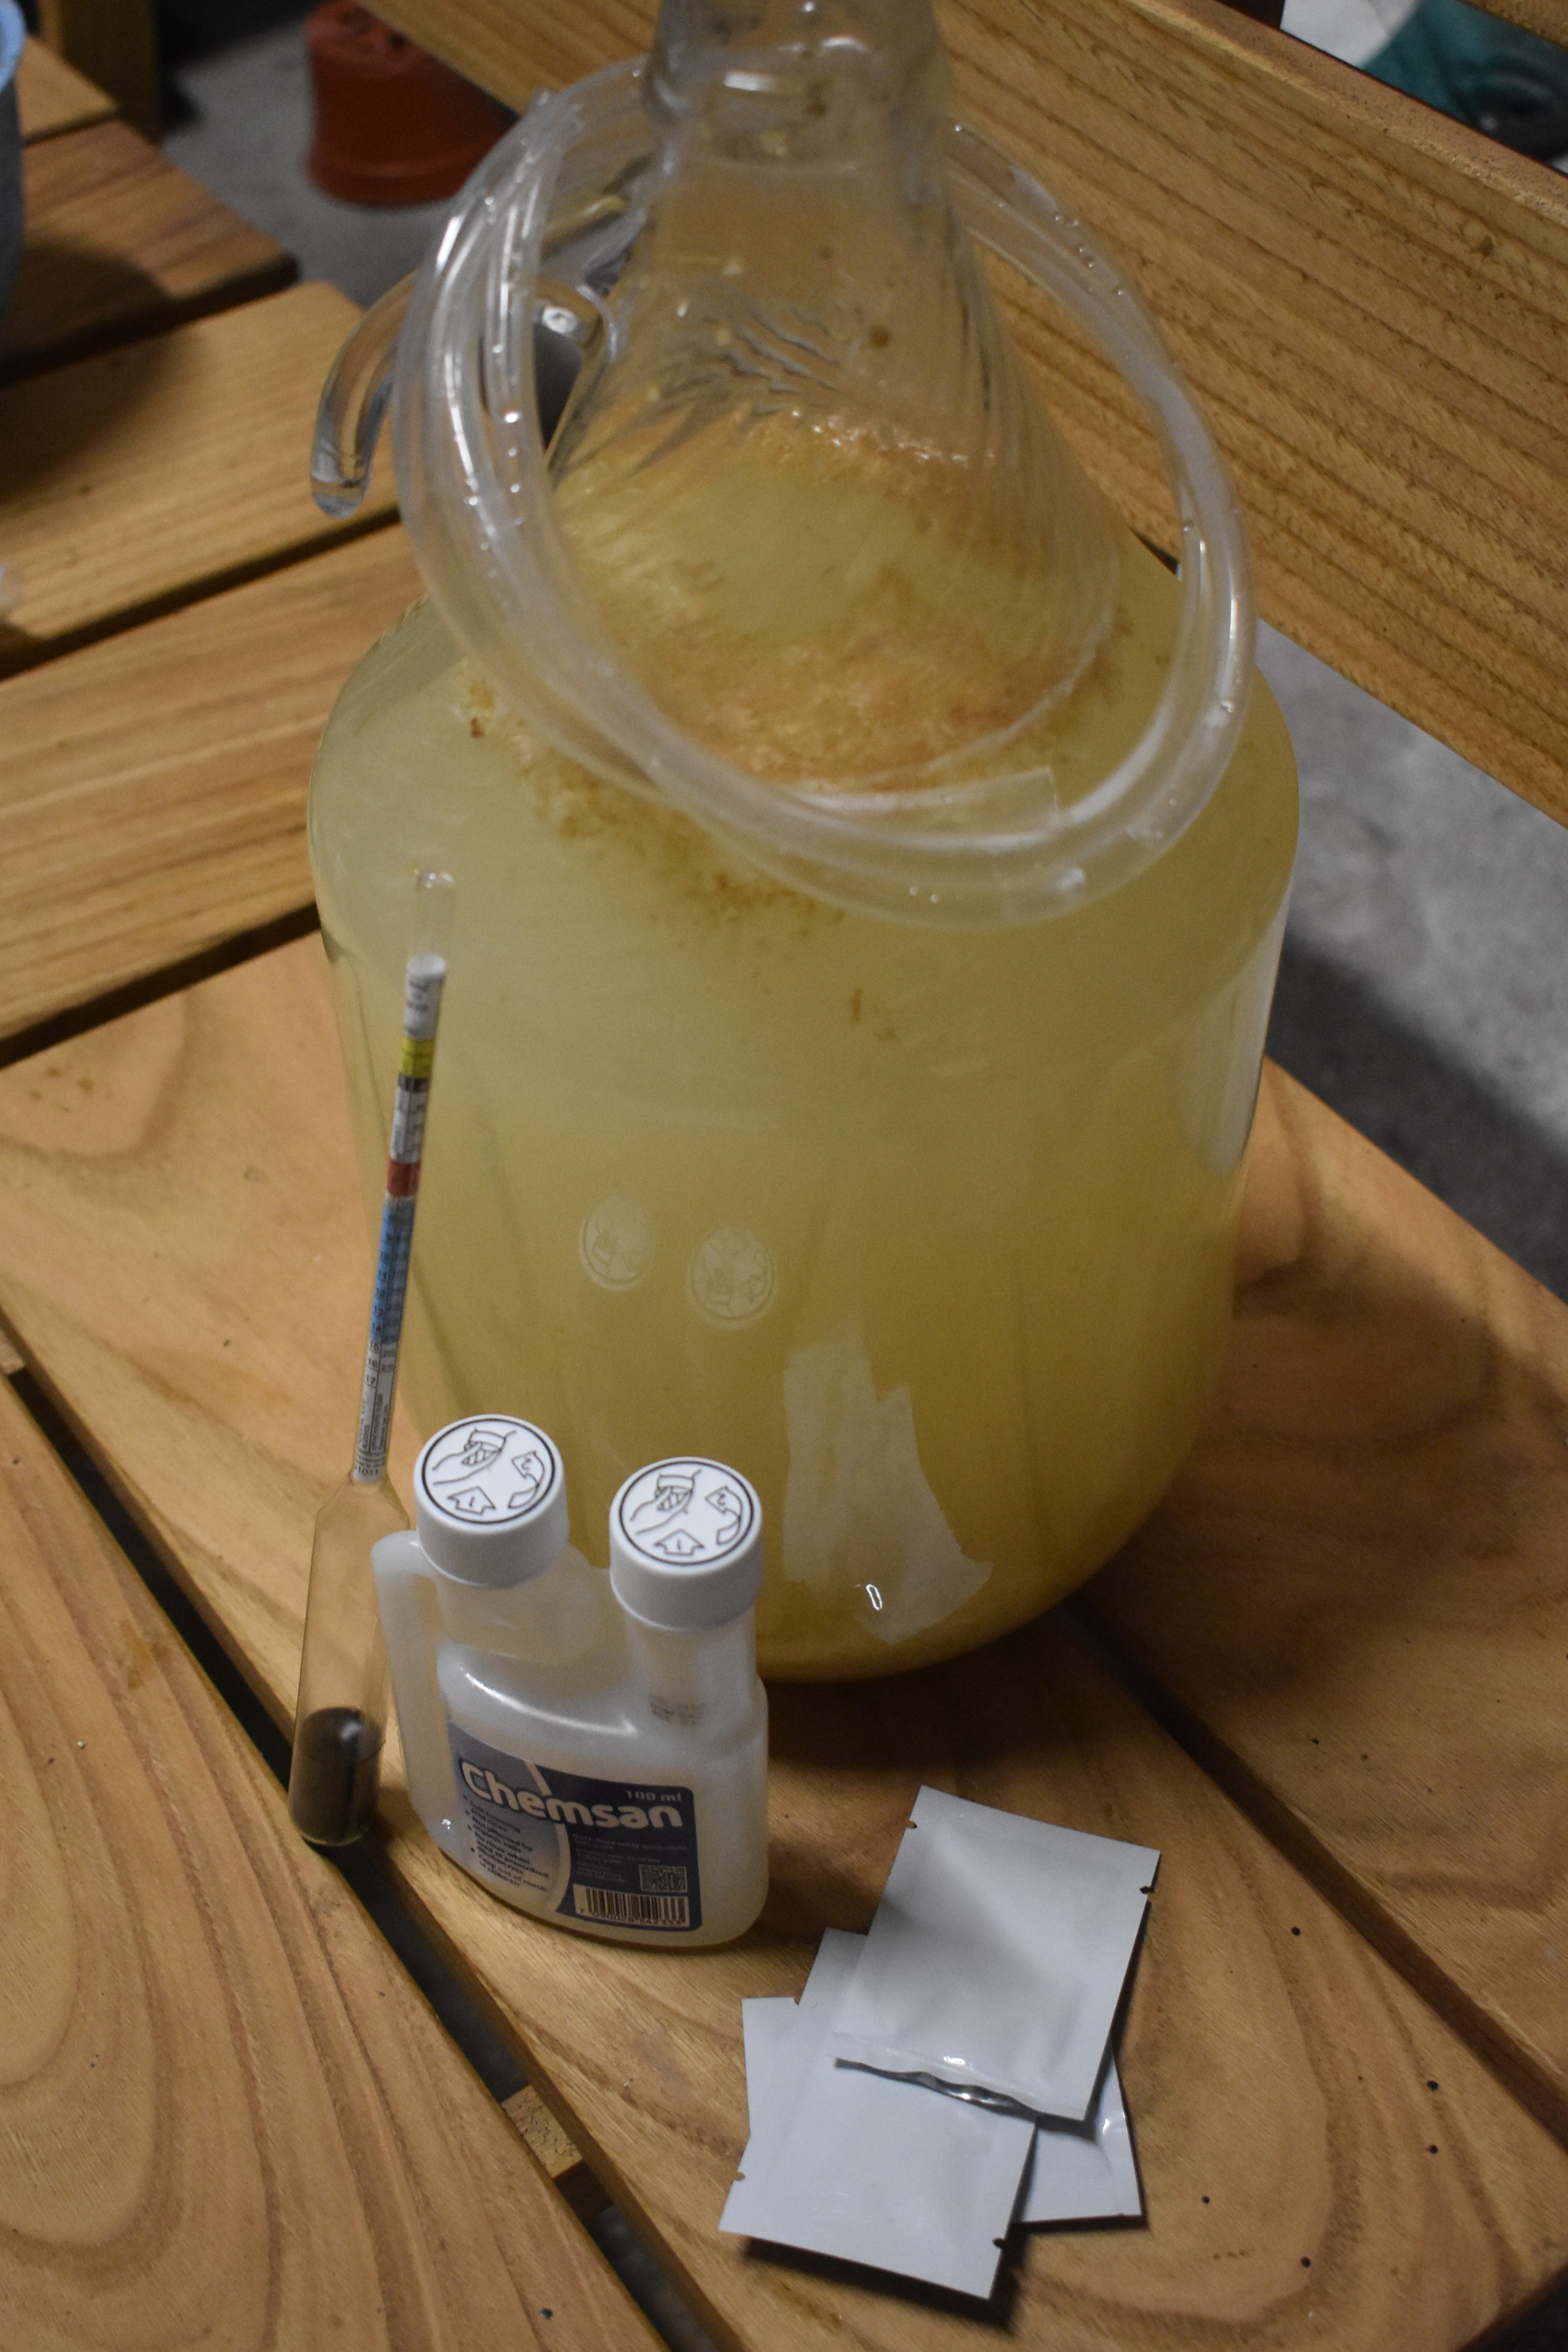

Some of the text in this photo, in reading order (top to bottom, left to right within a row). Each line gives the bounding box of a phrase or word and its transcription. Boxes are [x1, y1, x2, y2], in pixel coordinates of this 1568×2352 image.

[366, 1374, 376, 1385] 17
[460, 1757, 683, 1828] Chemsan
[627, 1790, 682, 1801] 100 ml
[522, 1843, 532, 1851] by
